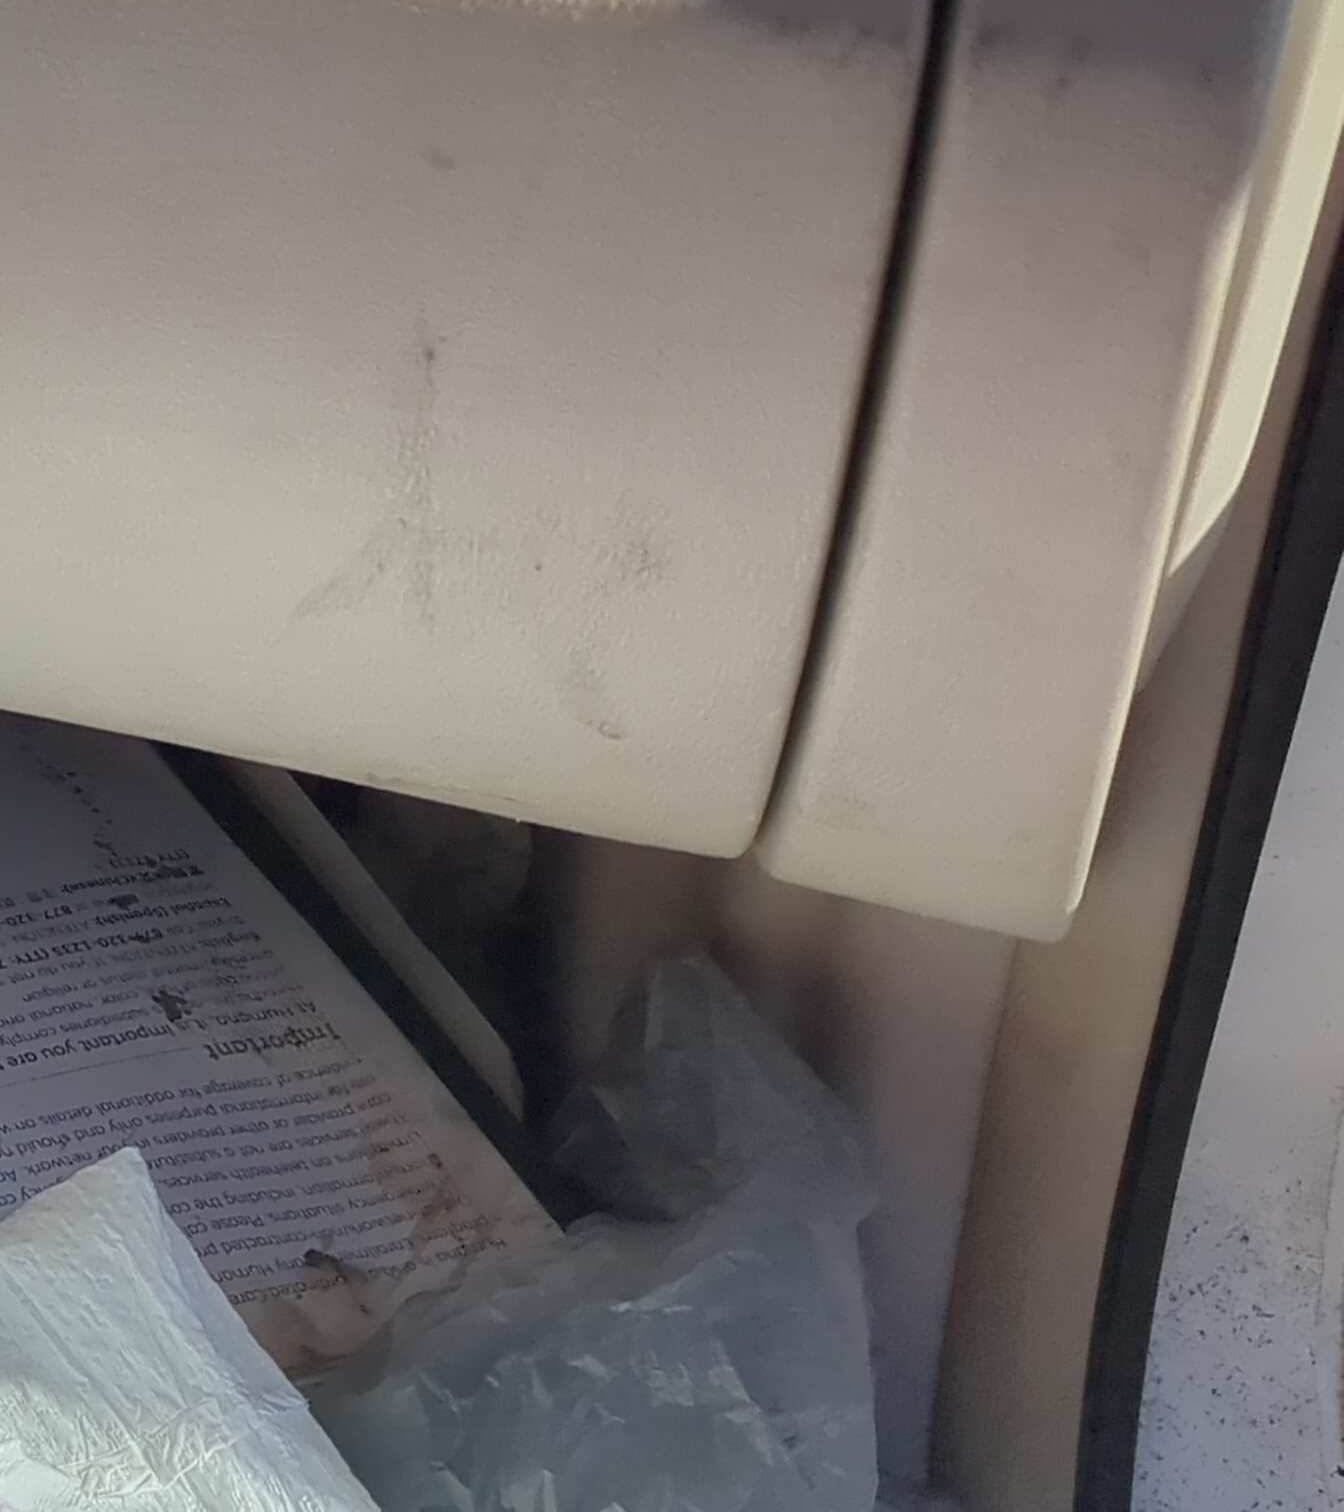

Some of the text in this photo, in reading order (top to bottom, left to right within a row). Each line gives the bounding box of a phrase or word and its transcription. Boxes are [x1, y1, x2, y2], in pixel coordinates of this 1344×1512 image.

[7, 947, 51, 969] (TTY:
[8, 970, 37, 987] not
[36, 965, 60, 981] do
[82, 979, 98, 990] or
[28, 999, 94, 1025] national
[190, 1018, 208, 1030] it
[76, 1019, 175, 1053] important
[201, 1016, 340, 1061] Important
[38, 1038, 77, 1058] you
[5, 1050, 38, 1066] are
[200, 1073, 271, 1095] coverage
[275, 1073, 292, 1086] of
[178, 1087, 203, 1101] for
[326, 1082, 350, 1098] for
[94, 1091, 176, 1116] additional
[219, 1089, 324, 1117] informational
[37, 1105, 94, 1128] details
[143, 1104, 218, 1125] purposes
[291, 1099, 355, 1128] provider
[13, 1117, 37, 1130] on
[107, 1114, 144, 1135] only
[228, 1121, 271, 1137] other
[272, 1118, 289, 1128] or
[73, 1125, 107, 1143] and
[151, 1124, 227, 1148] providers
[15, 1132, 72, 1155] should
[134, 1137, 151, 1151] in
[222, 1147, 235, 1156] a
[267, 1139, 294, 1152] are
[19, 1150, 93, 1178] network.
[309, 1155, 333, 1167] on
[229, 1160, 310, 1184] telehealth
[193, 1197, 225, 1212] the
[223, 1186, 297, 1208] including
[209, 1216, 265, 1233] Please
[330, 1236, 414, 1267] Enrollmen
[274, 1255, 306, 1270] any
[226, 1289, 268, 1307] Care
